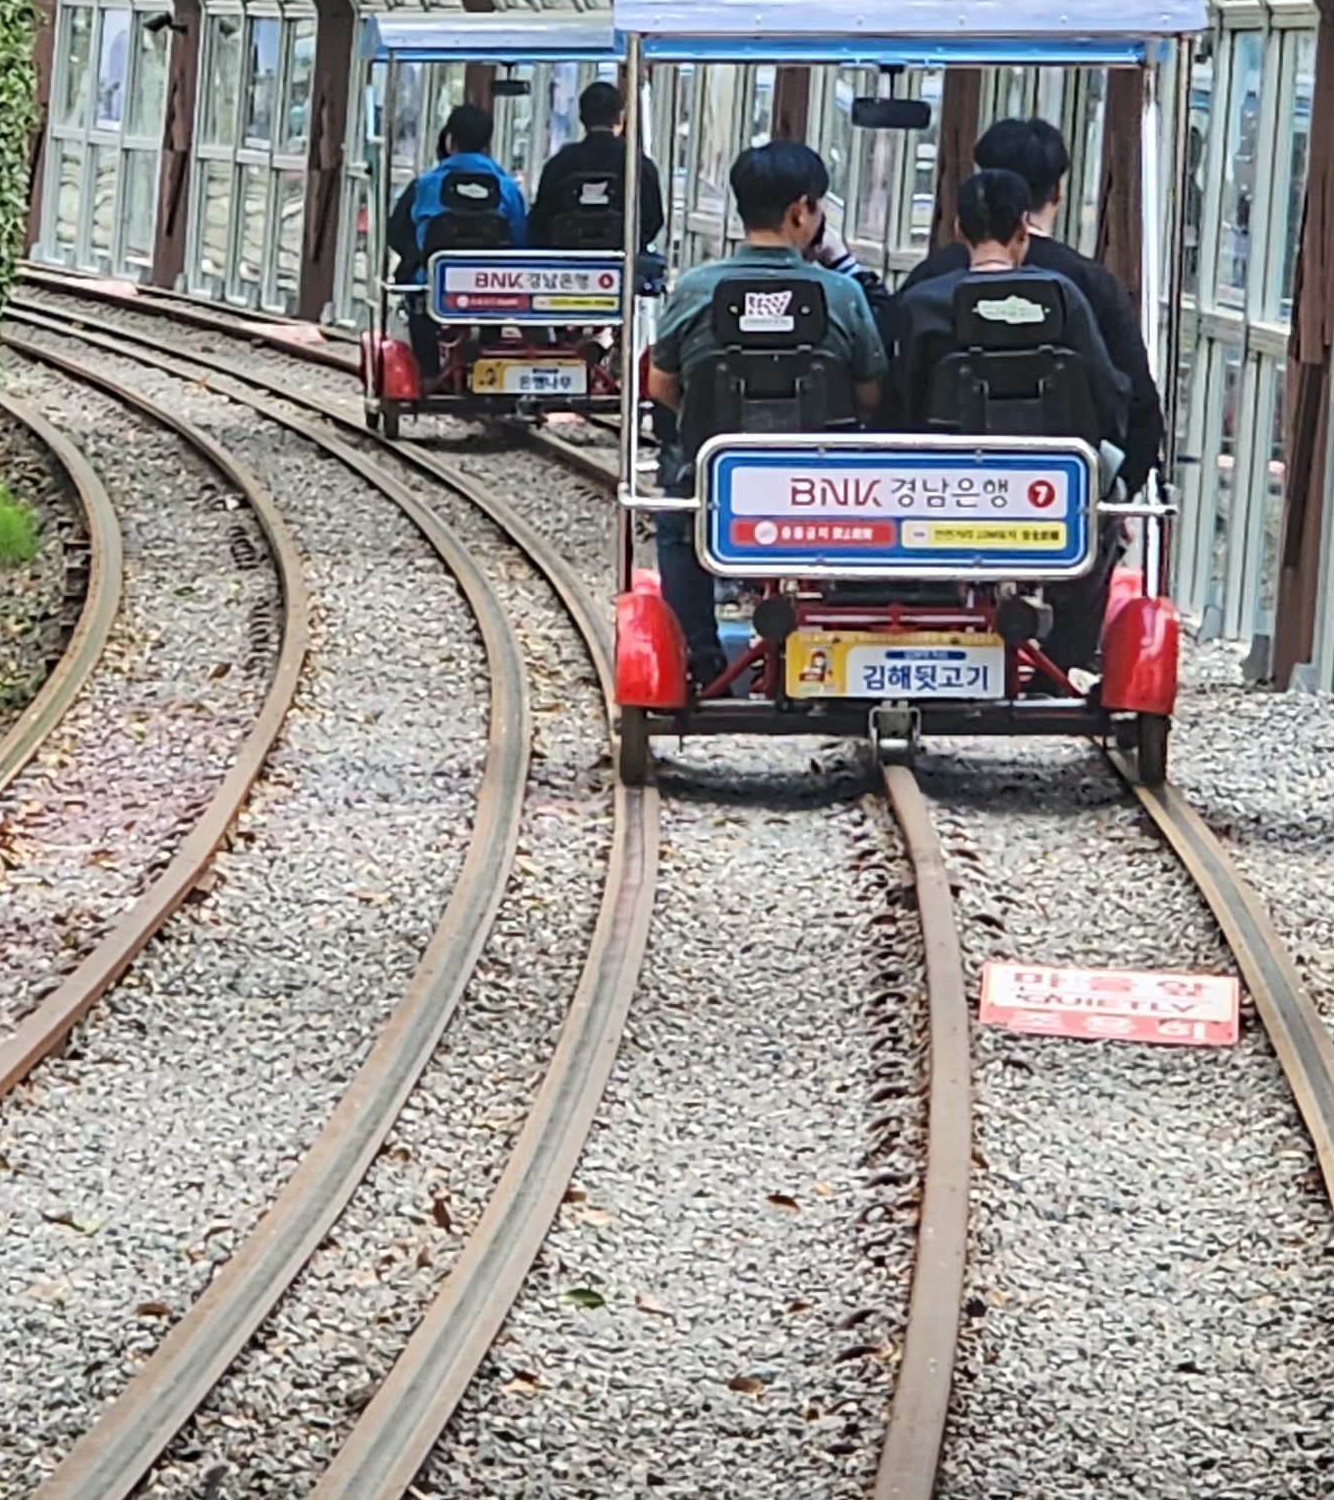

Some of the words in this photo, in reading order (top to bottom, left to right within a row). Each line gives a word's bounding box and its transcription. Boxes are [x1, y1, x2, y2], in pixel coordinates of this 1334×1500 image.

[475, 272, 523, 288] BNK
[790, 477, 883, 507] BNK
[890, 477, 1010, 509] 경남은행
[862, 664, 990, 692] 김해뒷고기
